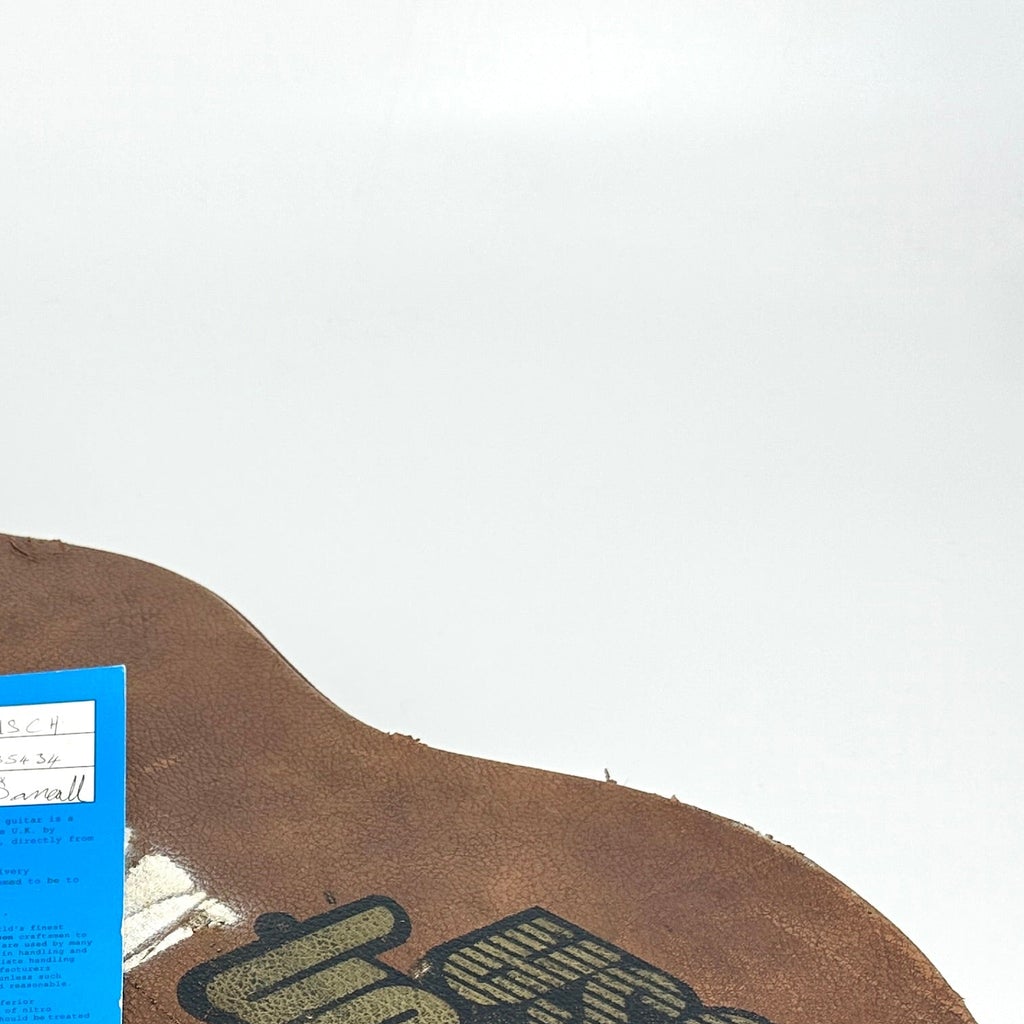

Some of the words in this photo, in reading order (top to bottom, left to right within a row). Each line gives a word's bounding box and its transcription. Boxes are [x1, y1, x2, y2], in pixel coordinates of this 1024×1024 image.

[4, 816, 42, 825] guitar
[11, 835, 61, 845] directly
[69, 834, 94, 842] from
[19, 931, 69, 939] craftsmen
[9, 980, 71, 989] reasonable.
